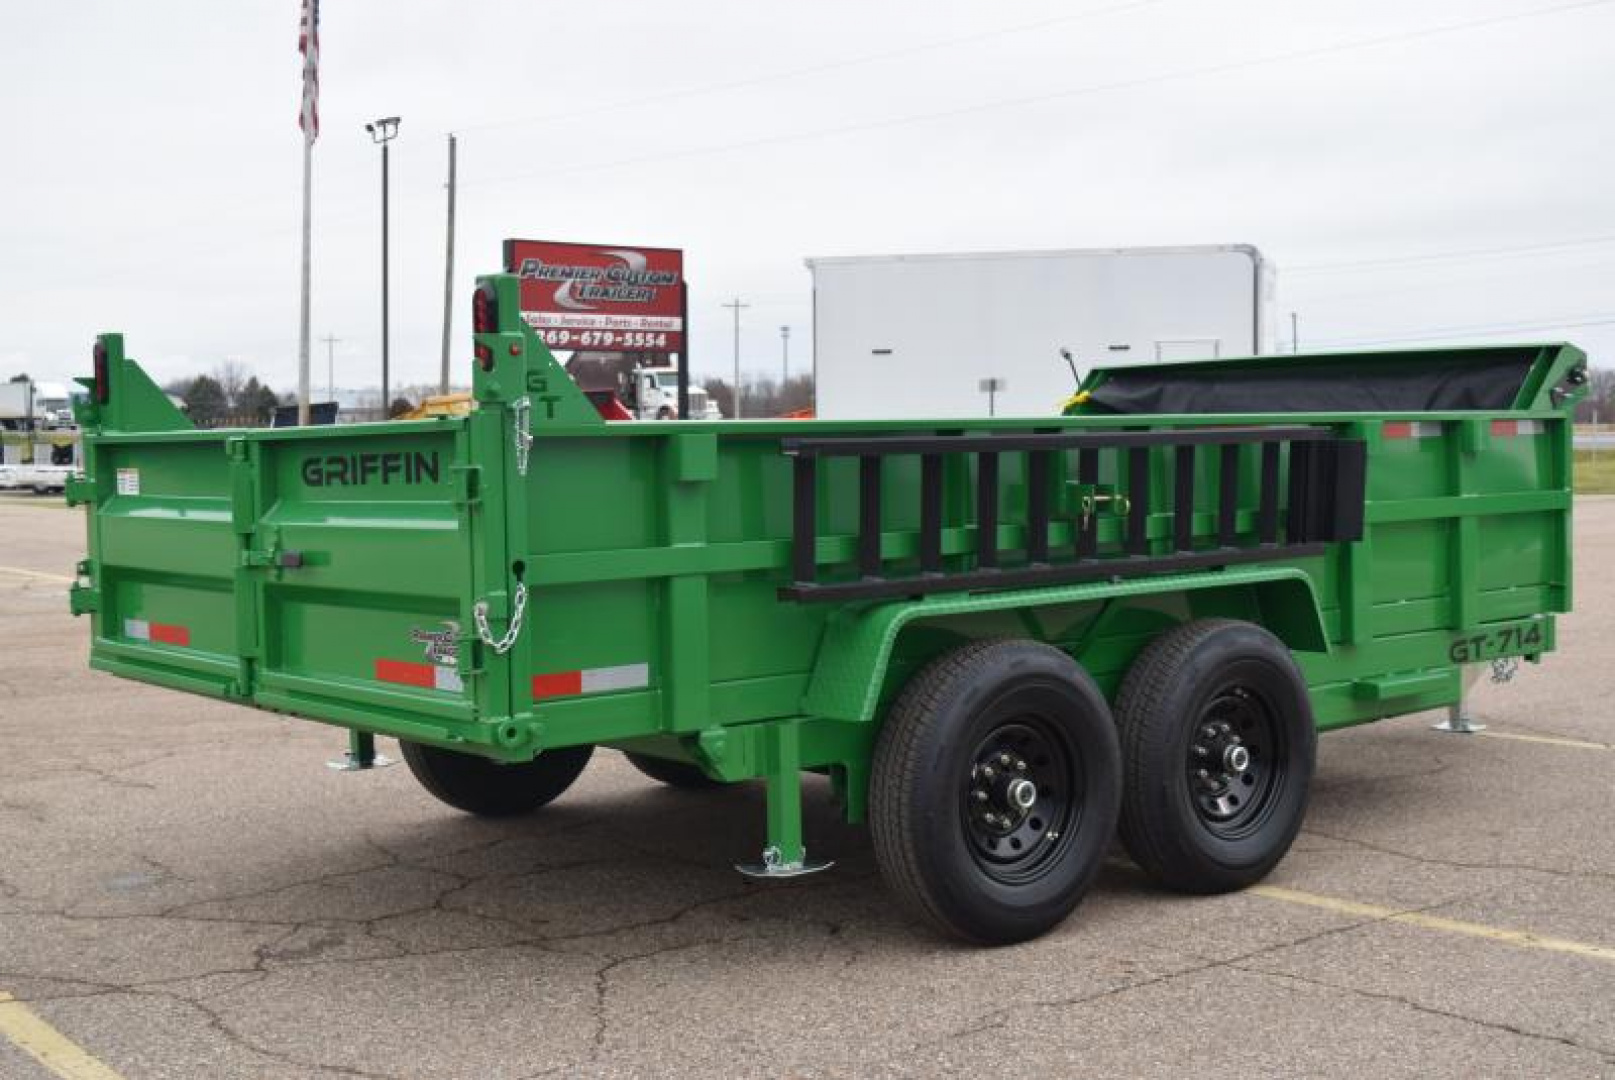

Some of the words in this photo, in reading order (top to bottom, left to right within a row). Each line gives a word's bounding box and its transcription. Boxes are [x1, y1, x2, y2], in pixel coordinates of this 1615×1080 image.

[520, 258, 601, 281] PREMIER
[539, 395, 562, 419] T
[302, 451, 439, 487] GRIFFIN
[1449, 623, 1542, 664] GT-714
